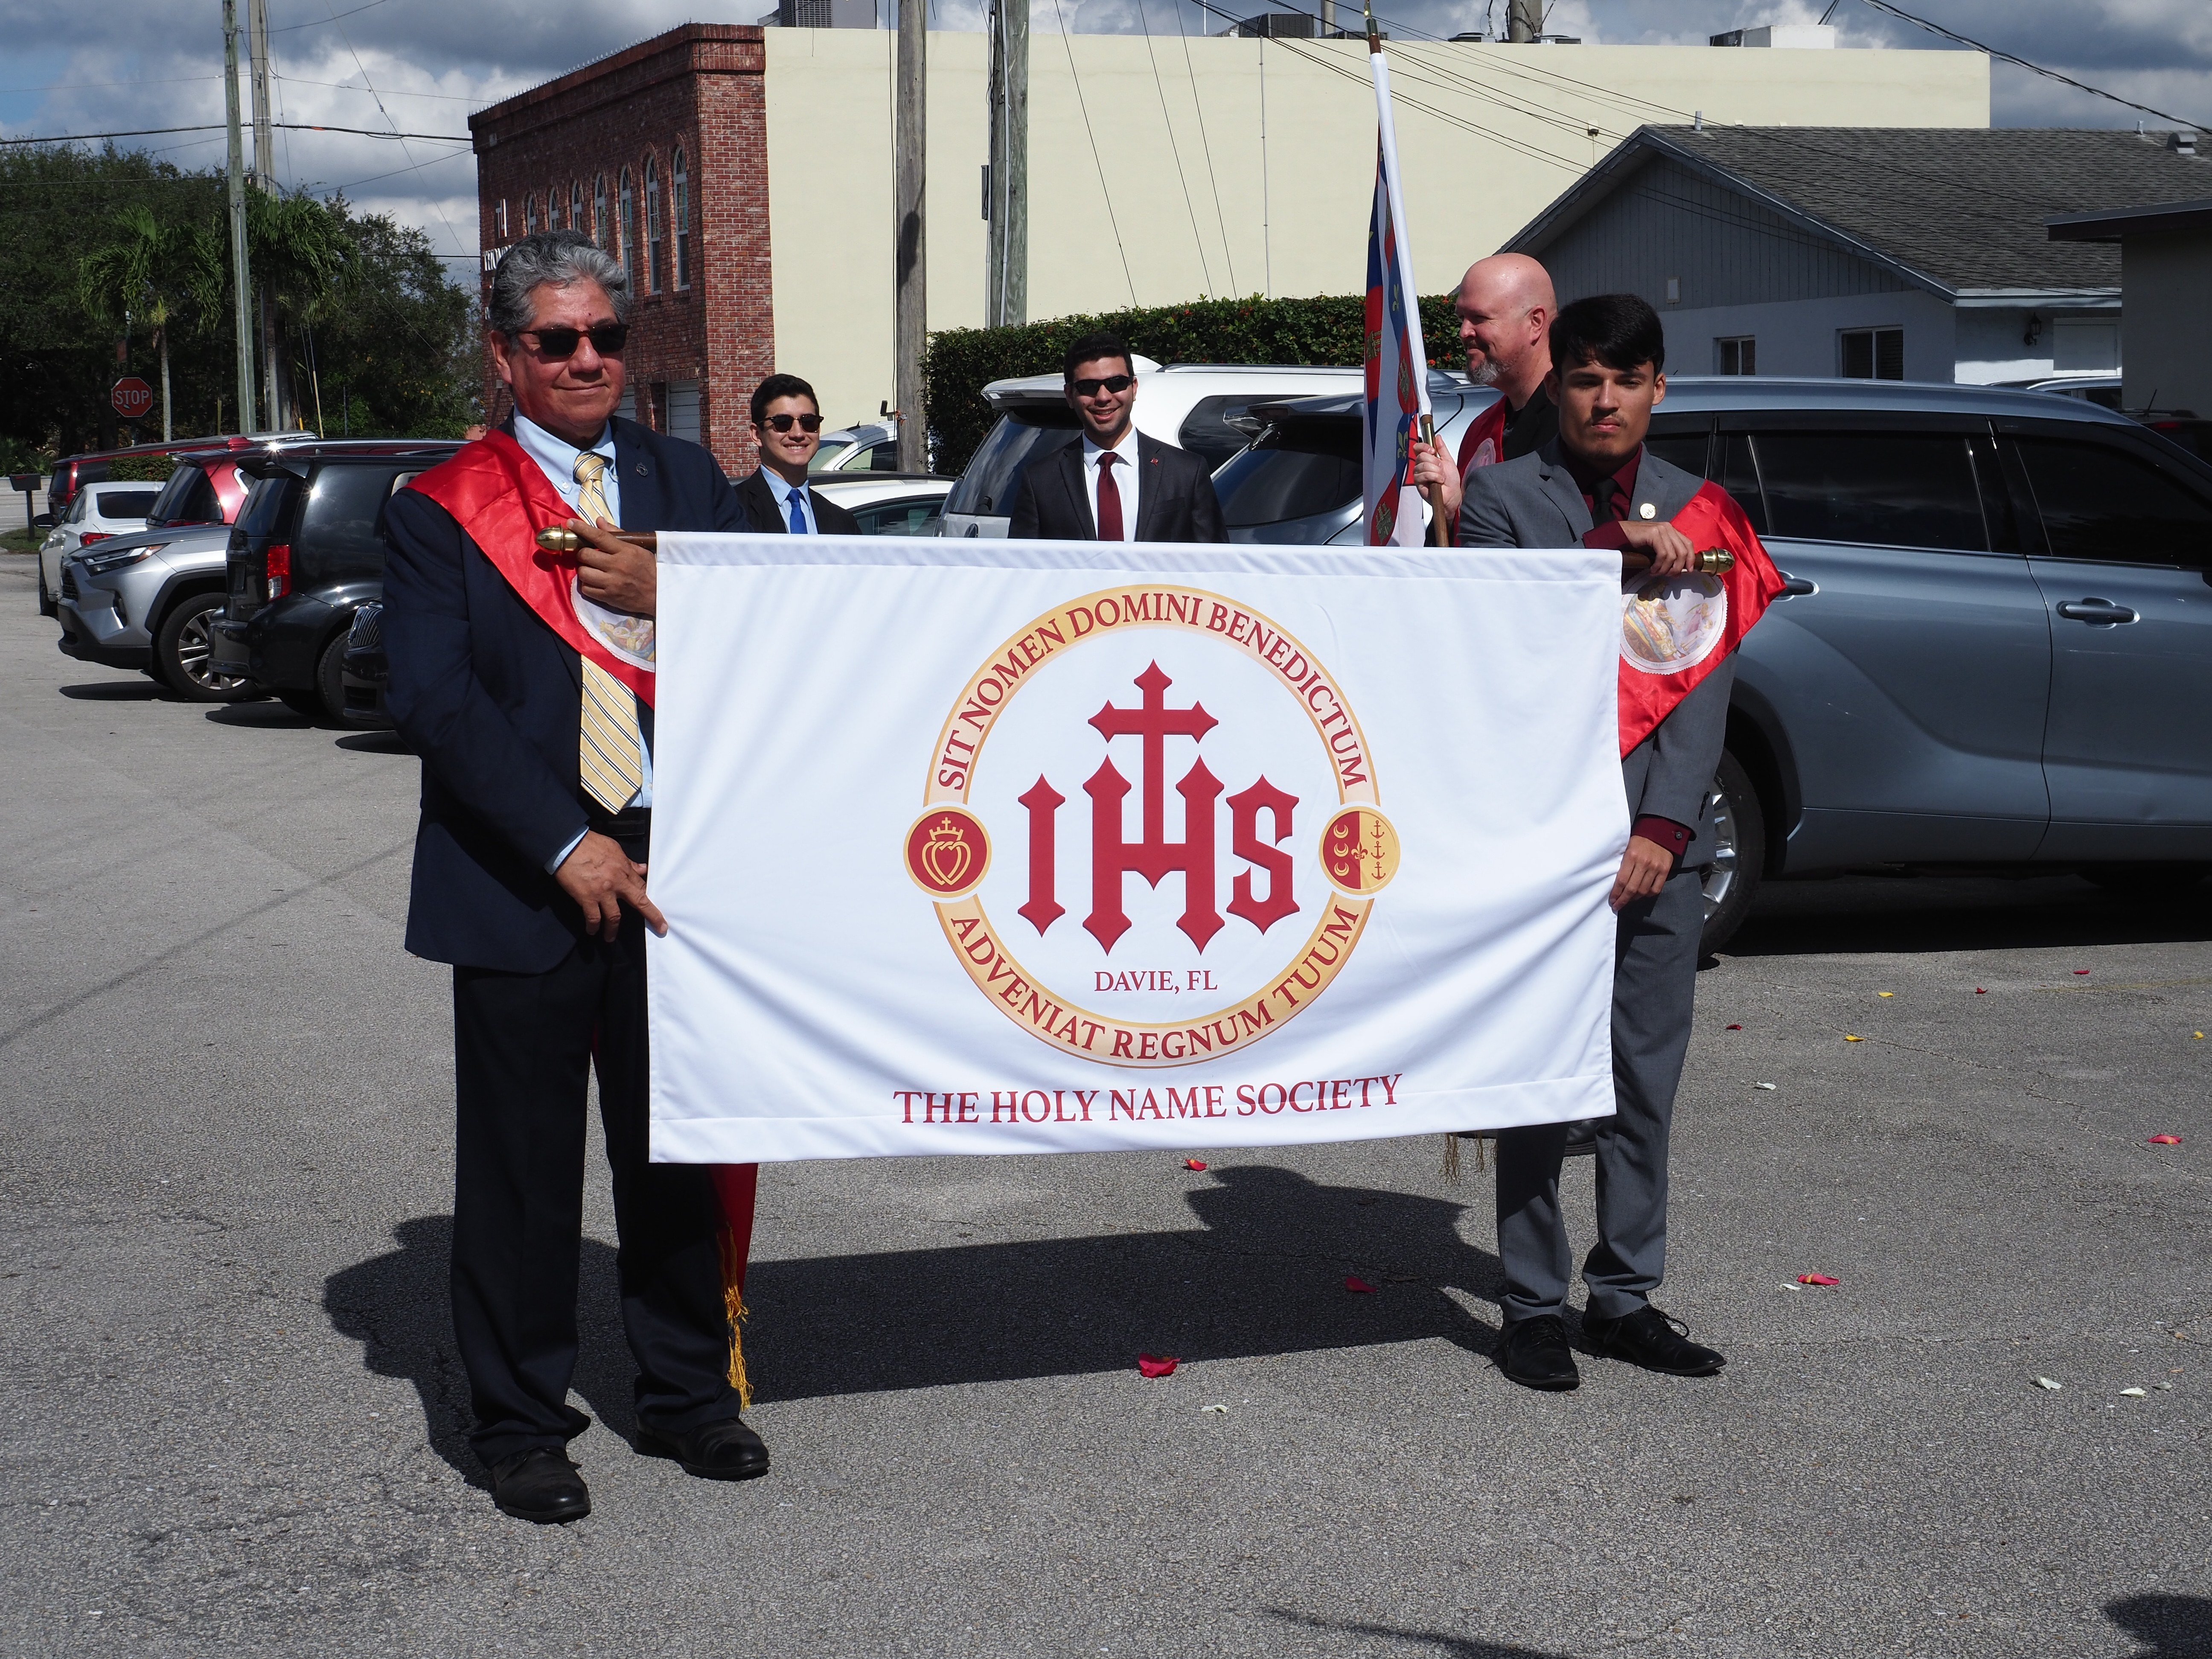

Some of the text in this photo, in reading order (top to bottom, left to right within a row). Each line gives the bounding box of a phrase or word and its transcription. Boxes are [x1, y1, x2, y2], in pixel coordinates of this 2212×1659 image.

[115, 390, 149, 405] STOP
[938, 593, 1367, 790] SIT NOMEN DOMINI BENEDICTUM
[1018, 754, 1300, 955] IHS
[951, 905, 1359, 1059] ADVENIAT REGNUM TUUM
[1094, 970, 1218, 995] DAVIE, FL
[893, 1073, 1403, 1123] THE HOLY NAME SOCIETY
